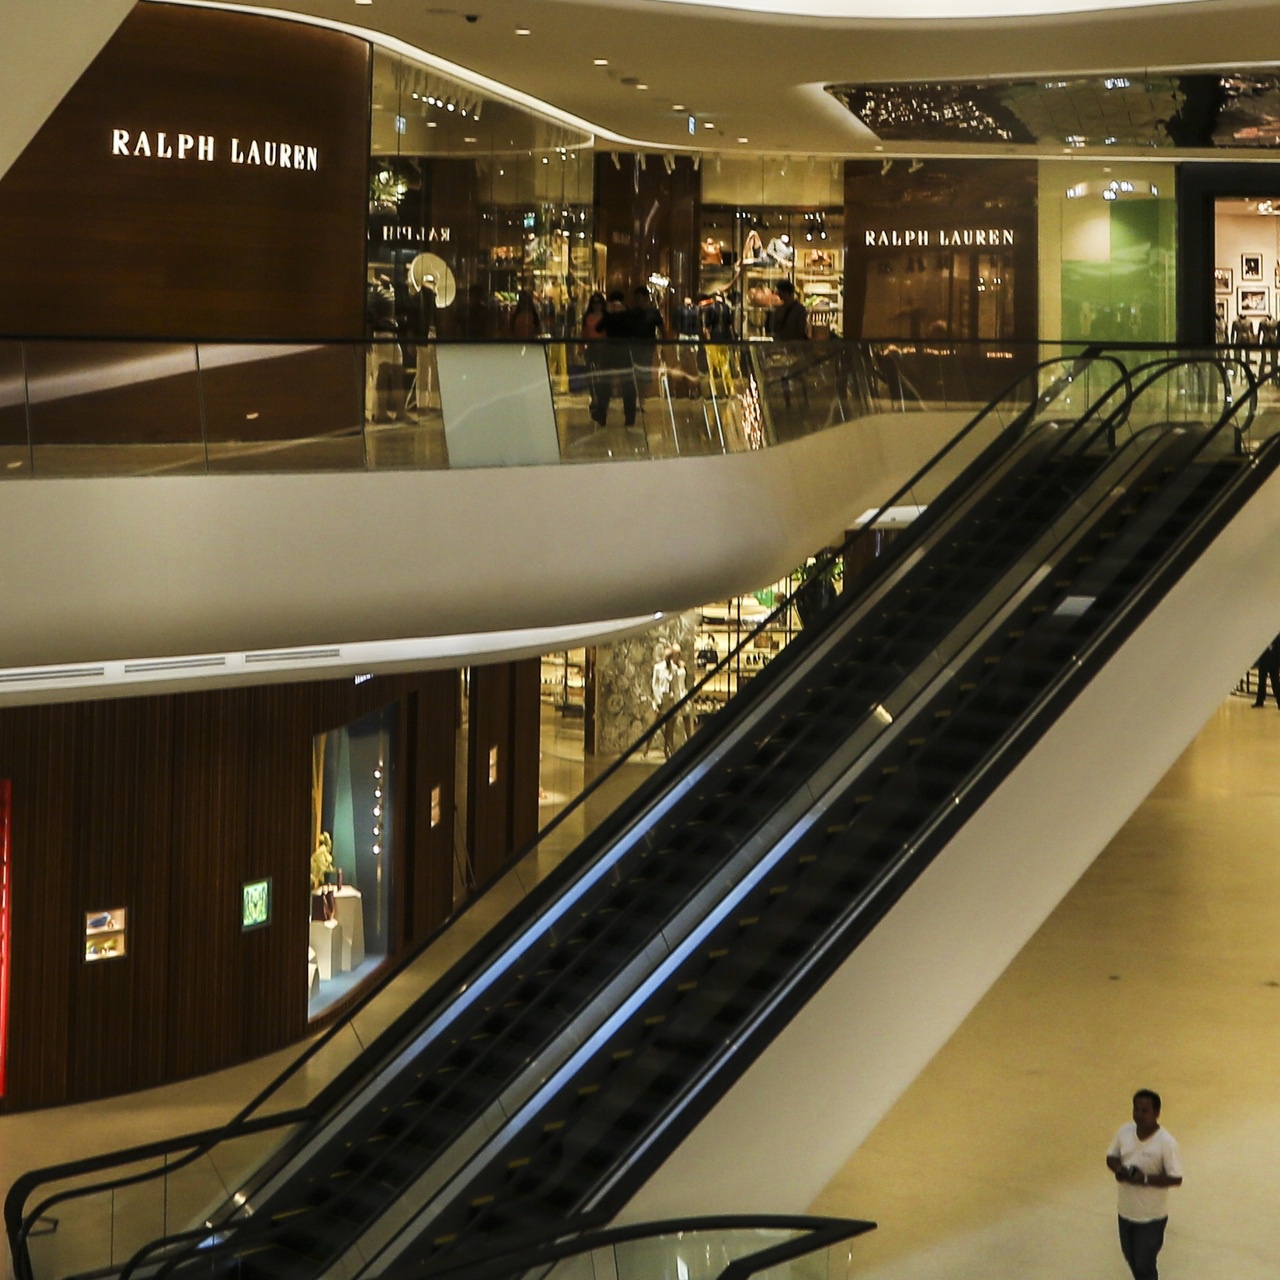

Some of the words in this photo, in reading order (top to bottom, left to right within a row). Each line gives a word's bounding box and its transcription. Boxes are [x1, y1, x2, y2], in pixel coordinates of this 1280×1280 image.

[112, 129, 214, 161] RALPH
[231, 138, 318, 171] LAUREN
[865, 230, 929, 246] RALPH
[939, 229, 1014, 246] LAUREN
